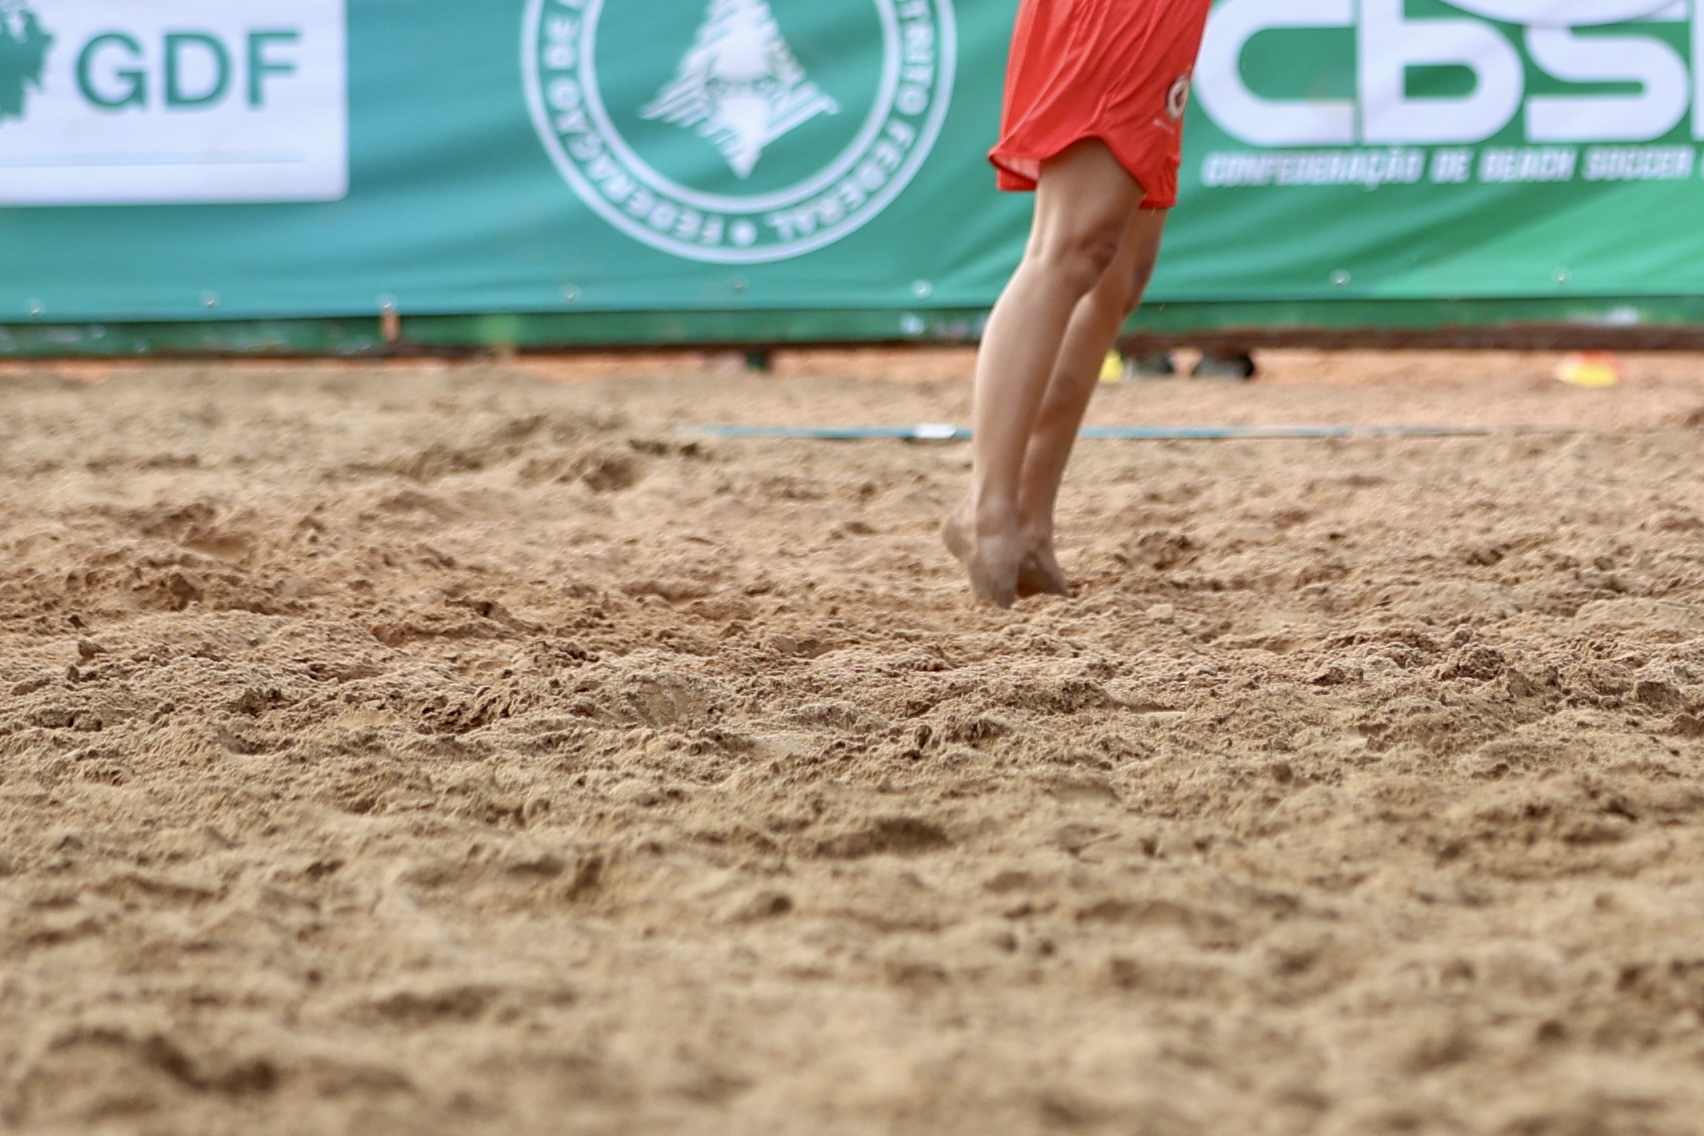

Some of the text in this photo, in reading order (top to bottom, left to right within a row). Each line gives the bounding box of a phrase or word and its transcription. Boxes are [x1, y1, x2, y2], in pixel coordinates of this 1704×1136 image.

[74, 31, 302, 111] GDF
[544, 14, 580, 72] DE
[764, 117, 917, 243] FEDERAL
[1430, 148, 1476, 183] DE
[1477, 147, 1579, 182] BEACH
[1582, 145, 1697, 180] SOCCER
